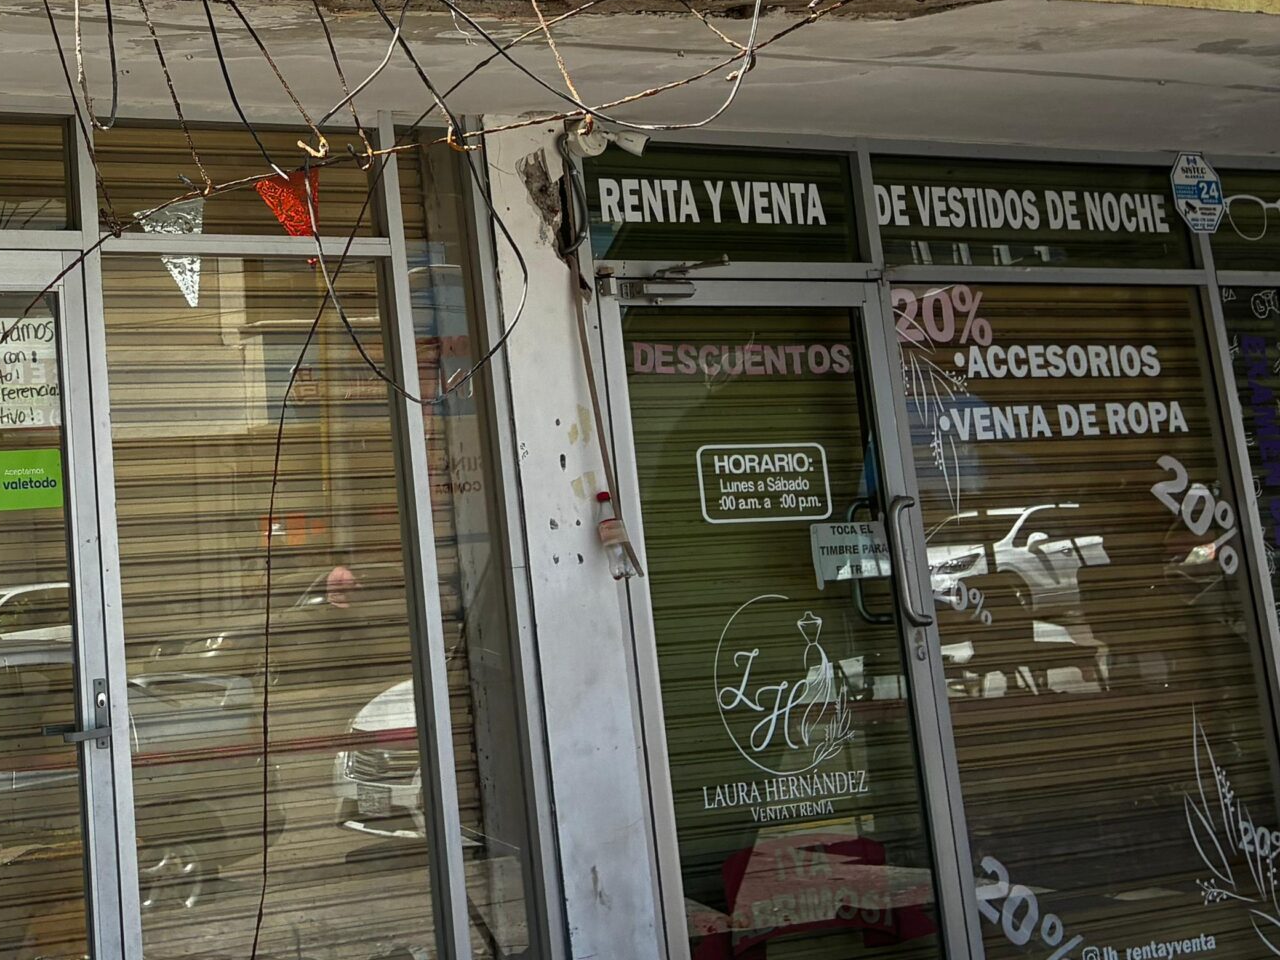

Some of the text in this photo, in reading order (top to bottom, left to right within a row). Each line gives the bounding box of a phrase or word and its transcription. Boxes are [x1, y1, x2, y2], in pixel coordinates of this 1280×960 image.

[1199, 182, 1219, 199] 24
[598, 178, 1170, 233] RENTA Y VENTA DE VESTIDOS DE NOCHE
[891, 284, 993, 346] 20%
[632, 342, 852, 375] DESCUENTOS
[967, 345, 1161, 378] ACCESORIOS
[950, 400, 1189, 441] VENTA DE ROPA
[713, 452, 814, 474] HORARIO:
[3, 477, 57, 490] valetodo
[720, 476, 810, 493] Lunes a Sábado
[764, 498, 771, 508] a
[798, 494, 821, 512] p.m.
[1150, 455, 1238, 575] 20%
[830, 524, 874, 535] TOCA EL
[820, 544, 890, 556] TIMBRE PARA
[703, 769, 869, 810] LAURA HERNÁNDEZ
[751, 801, 834, 822] VENTA Y RENTA
